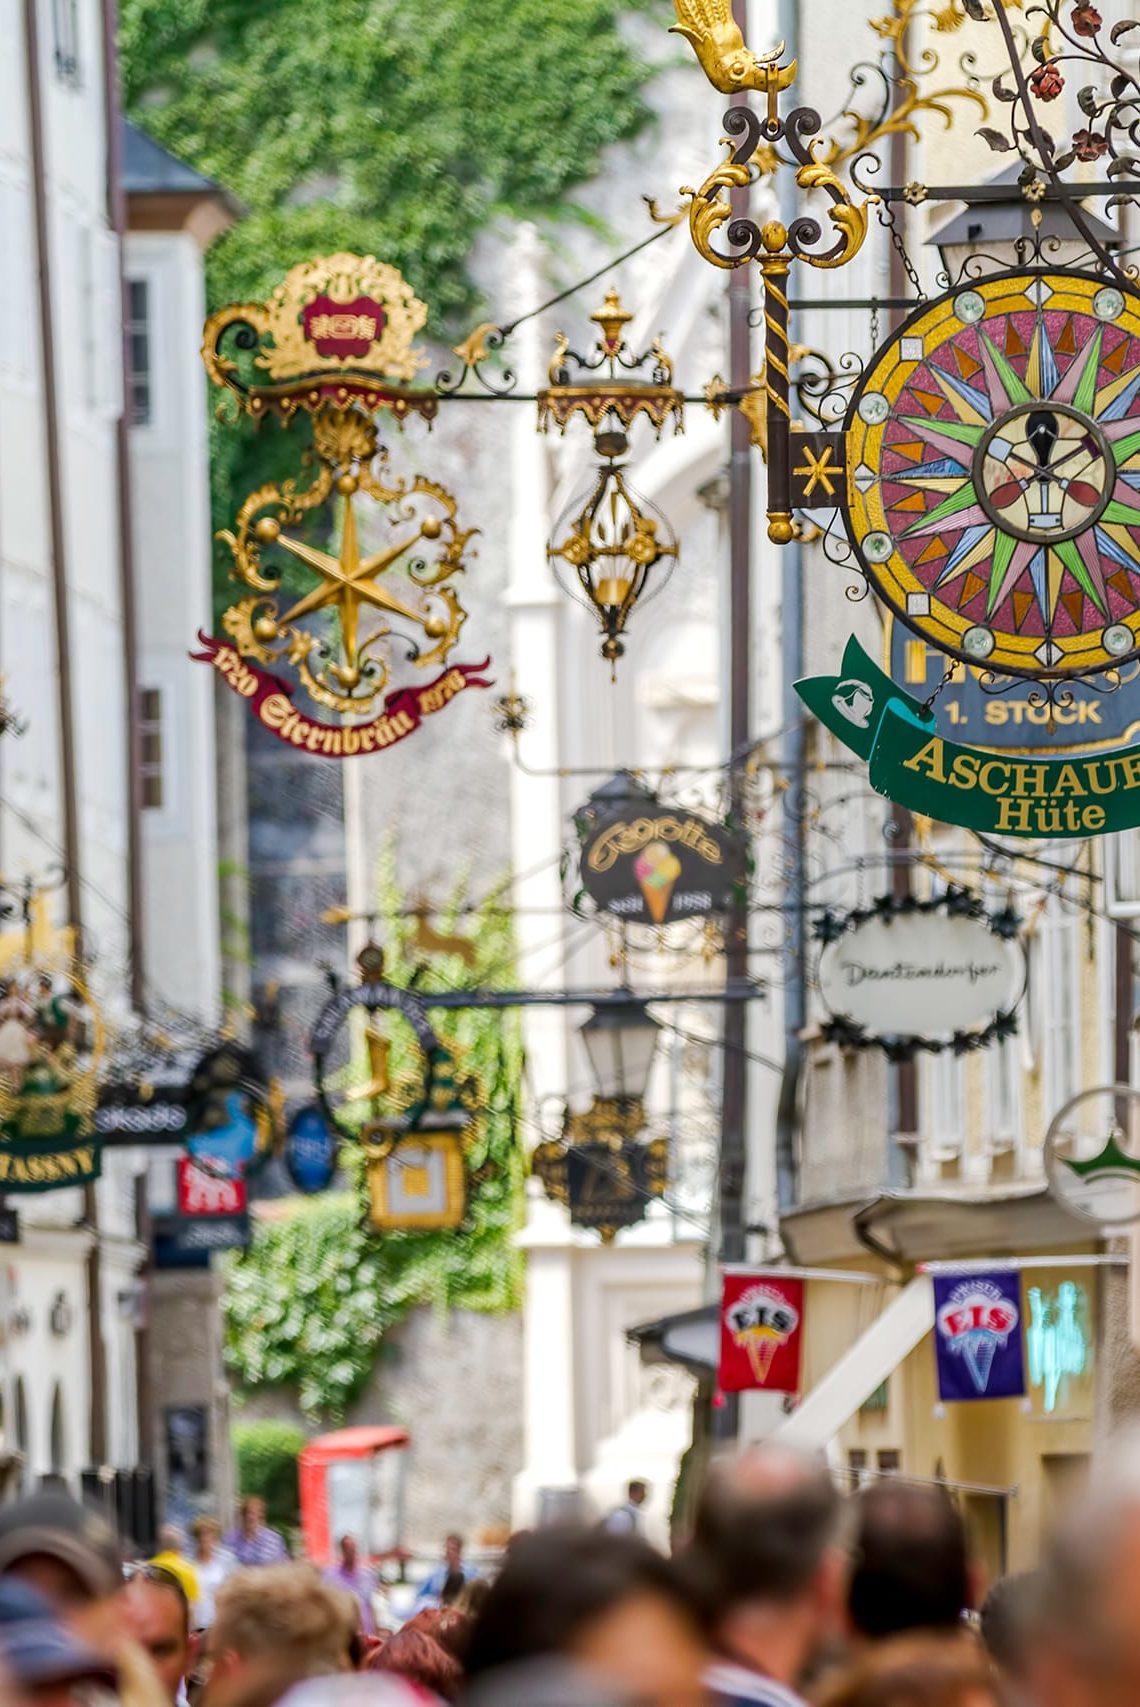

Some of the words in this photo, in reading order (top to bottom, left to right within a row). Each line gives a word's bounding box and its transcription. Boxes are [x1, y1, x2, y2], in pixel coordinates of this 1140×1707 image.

[213, 647, 259, 697] 1720
[260, 693, 415, 755] Sternbräu
[944, 701, 969, 725] 1.
[984, 699, 1103, 725] STOCK
[902, 736, 1140, 797] ASCHAUE
[994, 797, 1106, 832] Hüte
[732, 1306, 792, 1333] EIS
[944, 1305, 1013, 1337] EIS
